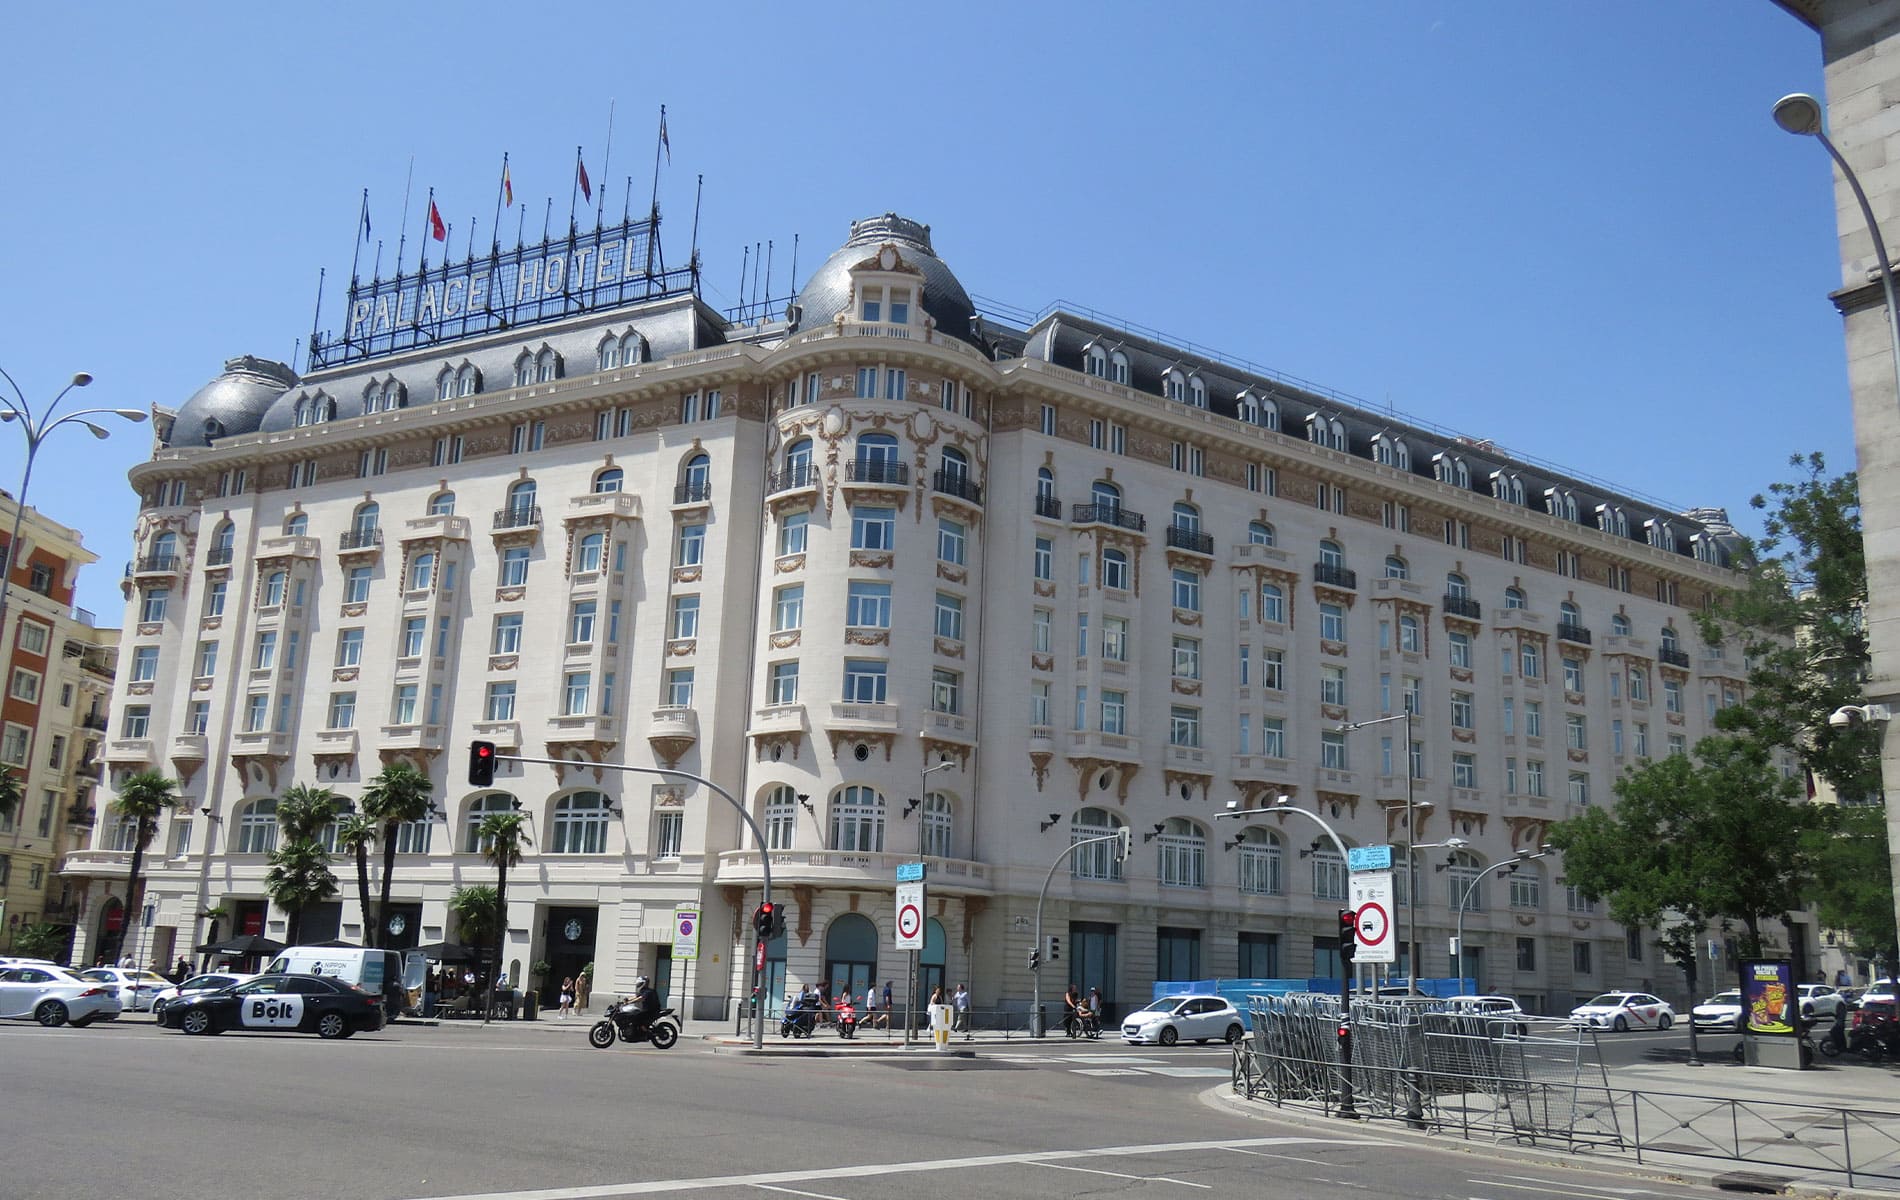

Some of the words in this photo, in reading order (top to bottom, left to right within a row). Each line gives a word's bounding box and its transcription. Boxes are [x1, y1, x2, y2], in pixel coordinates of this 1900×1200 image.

[350, 272, 490, 337] PALACE
[518, 238, 646, 301] HOTEL
[252, 1001, 293, 1019] Bolt
